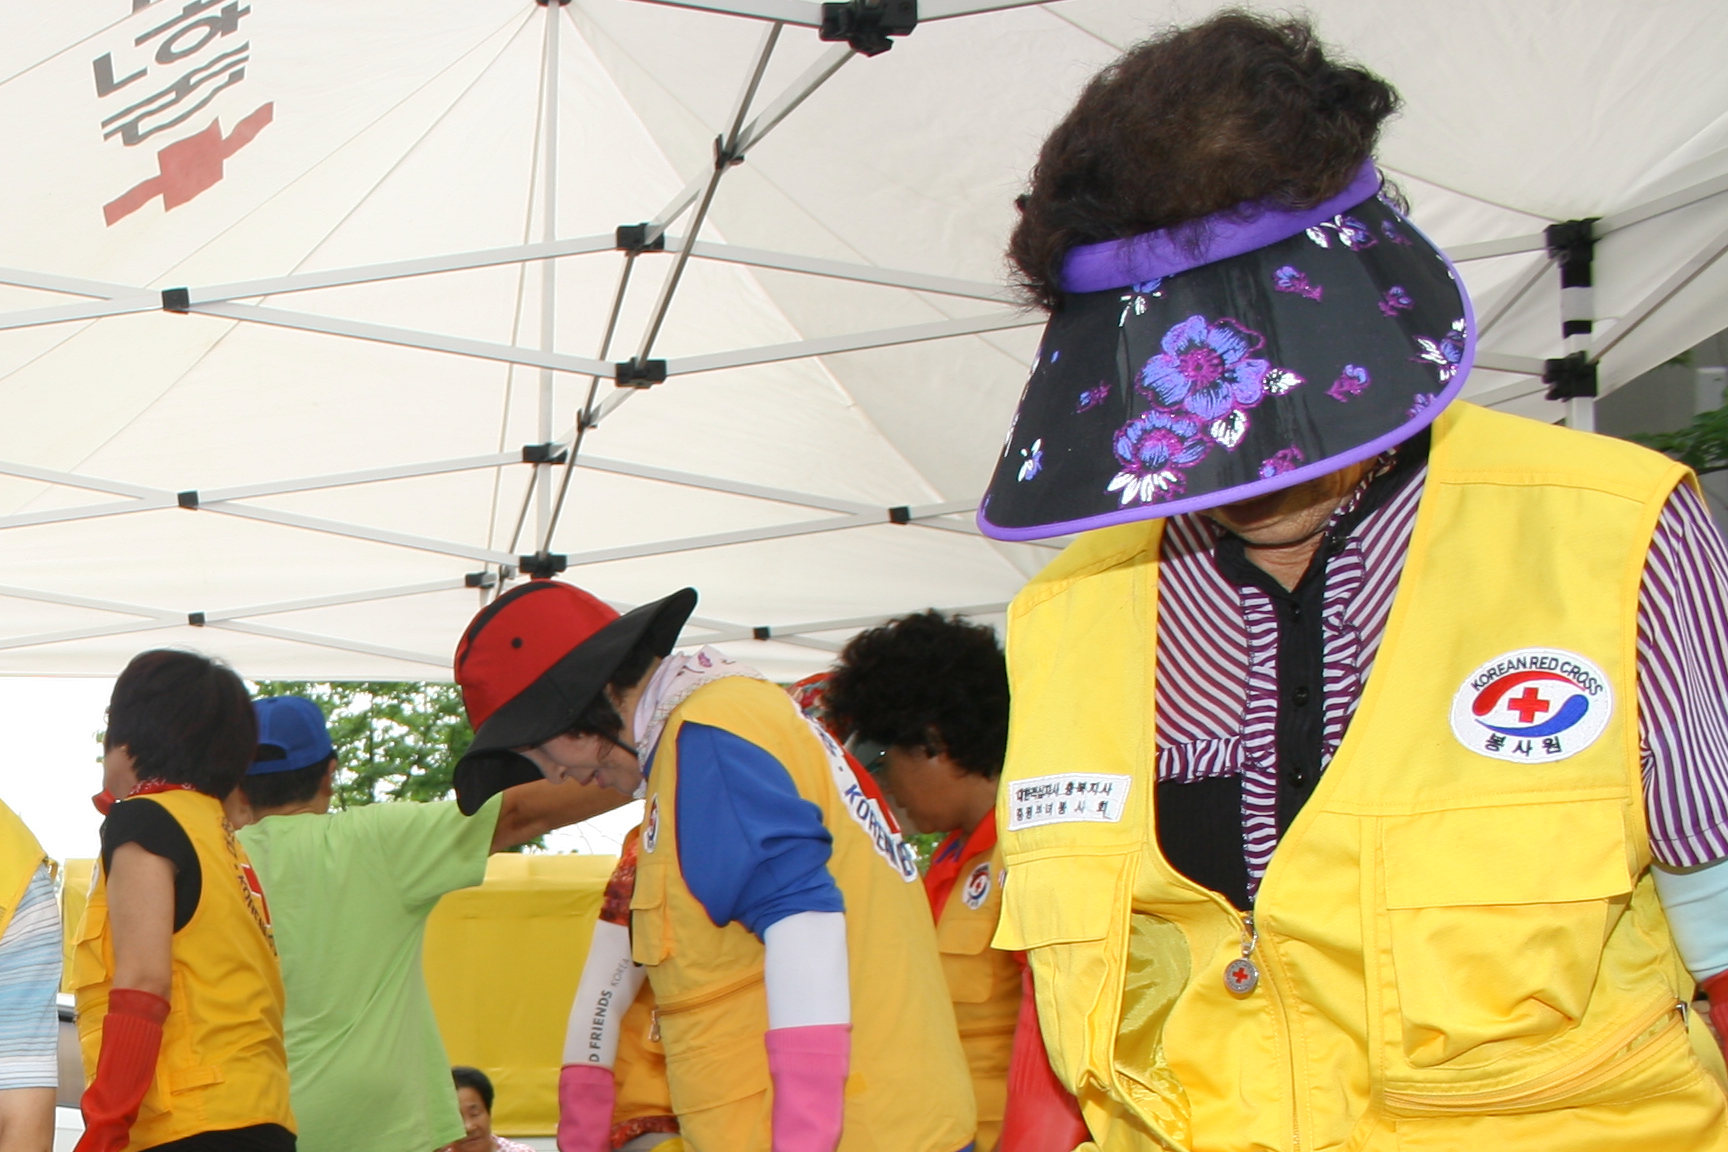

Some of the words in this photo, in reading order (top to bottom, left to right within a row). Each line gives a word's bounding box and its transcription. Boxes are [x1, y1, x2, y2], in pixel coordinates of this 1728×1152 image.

[1470, 656, 1527, 691] KOREAN
[1529, 656, 1559, 671] RED
[1560, 661, 1604, 696] CROSS
[1484, 733, 1563, 757] 봉사원
[589, 989, 613, 1050] FRIENDS
